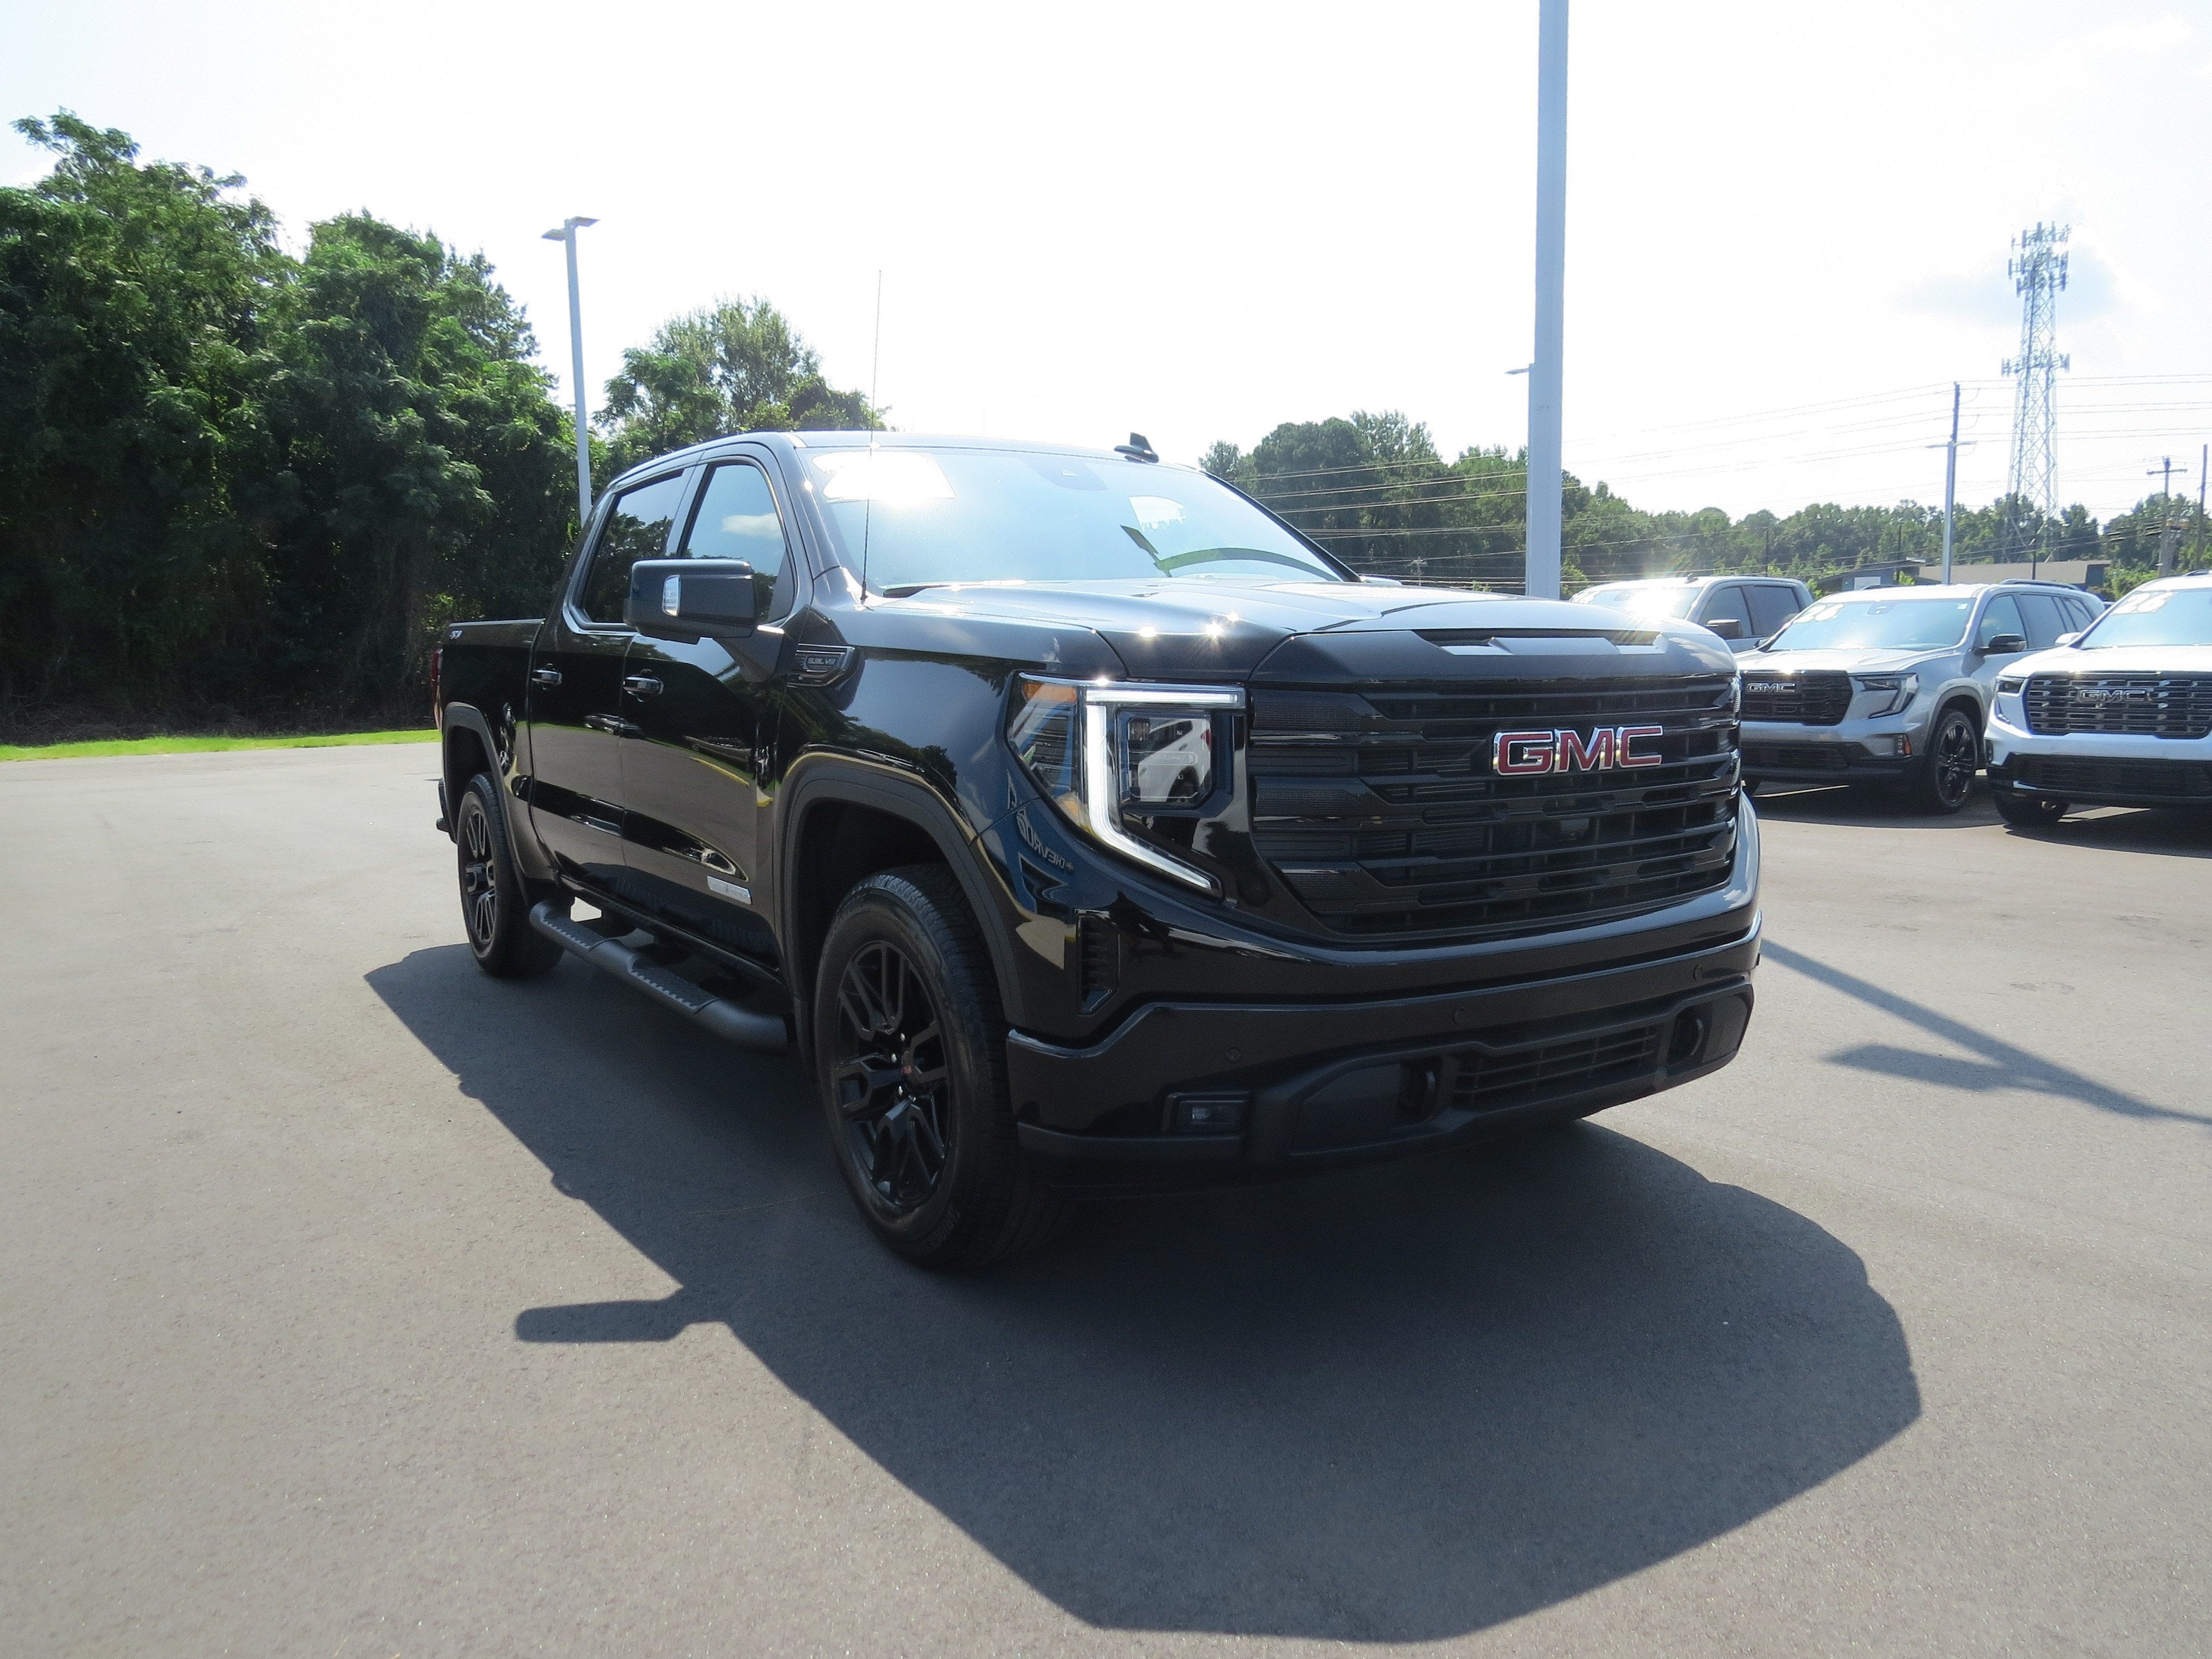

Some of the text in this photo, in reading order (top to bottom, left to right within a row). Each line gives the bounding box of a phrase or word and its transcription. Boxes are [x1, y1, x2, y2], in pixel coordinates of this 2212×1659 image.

[1747, 682, 1796, 693] GMC
[2080, 690, 2146, 702] GMC
[1494, 725, 1663, 775] GMC
